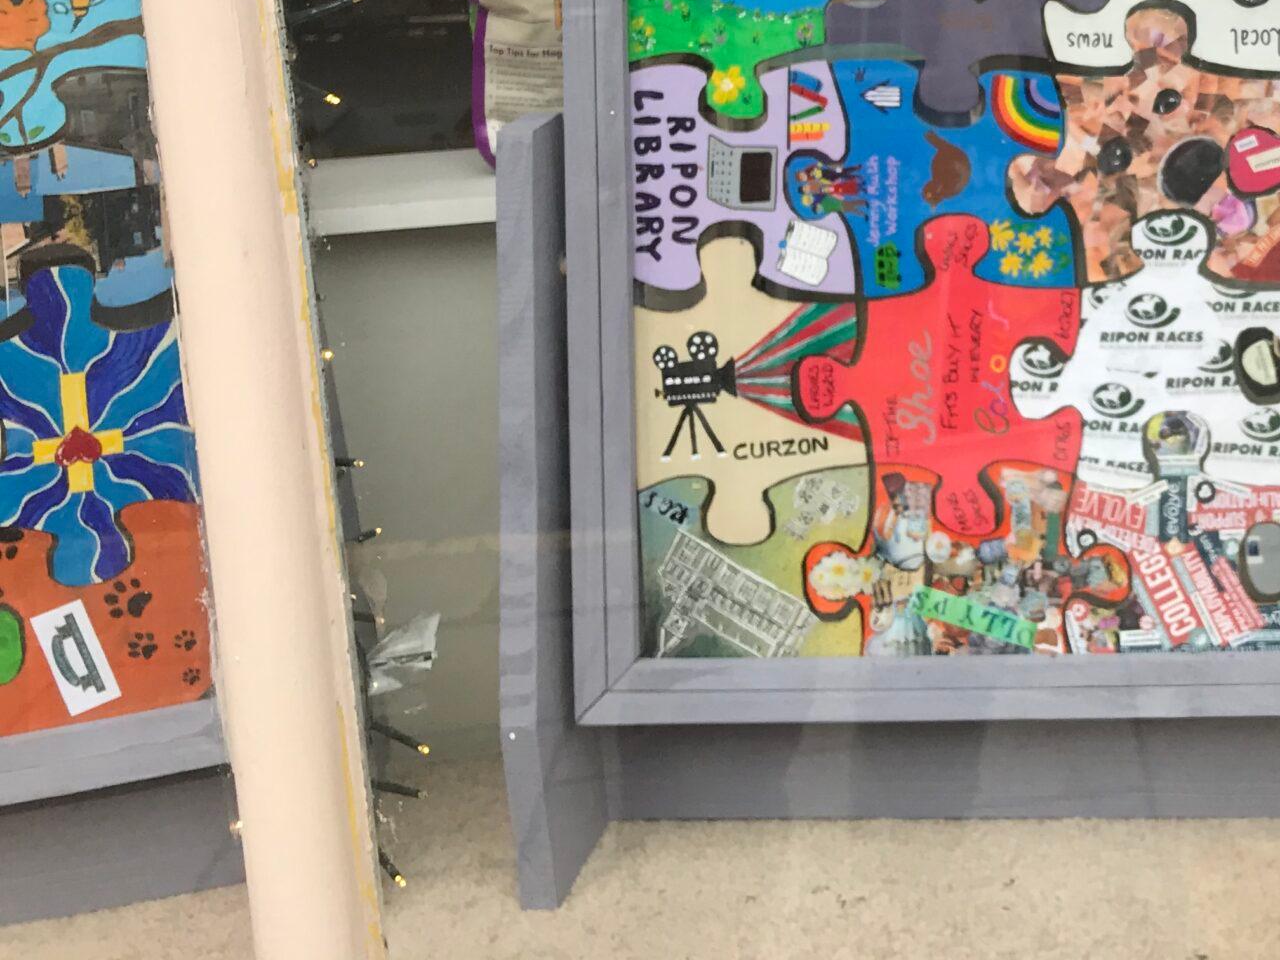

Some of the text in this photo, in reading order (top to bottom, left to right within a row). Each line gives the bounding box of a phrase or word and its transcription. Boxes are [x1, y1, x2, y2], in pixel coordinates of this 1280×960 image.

[1066, 31, 1114, 50] news
[633, 89, 666, 263] LIBRARY
[666, 115, 700, 245] RIPON
[1099, 330, 1204, 344] RIPON RACES
[895, 330, 937, 446] Shoe
[1165, 376, 1216, 390] RIPON
[732, 436, 829, 460] CURZON
[1211, 441, 1265, 457] RIPON
